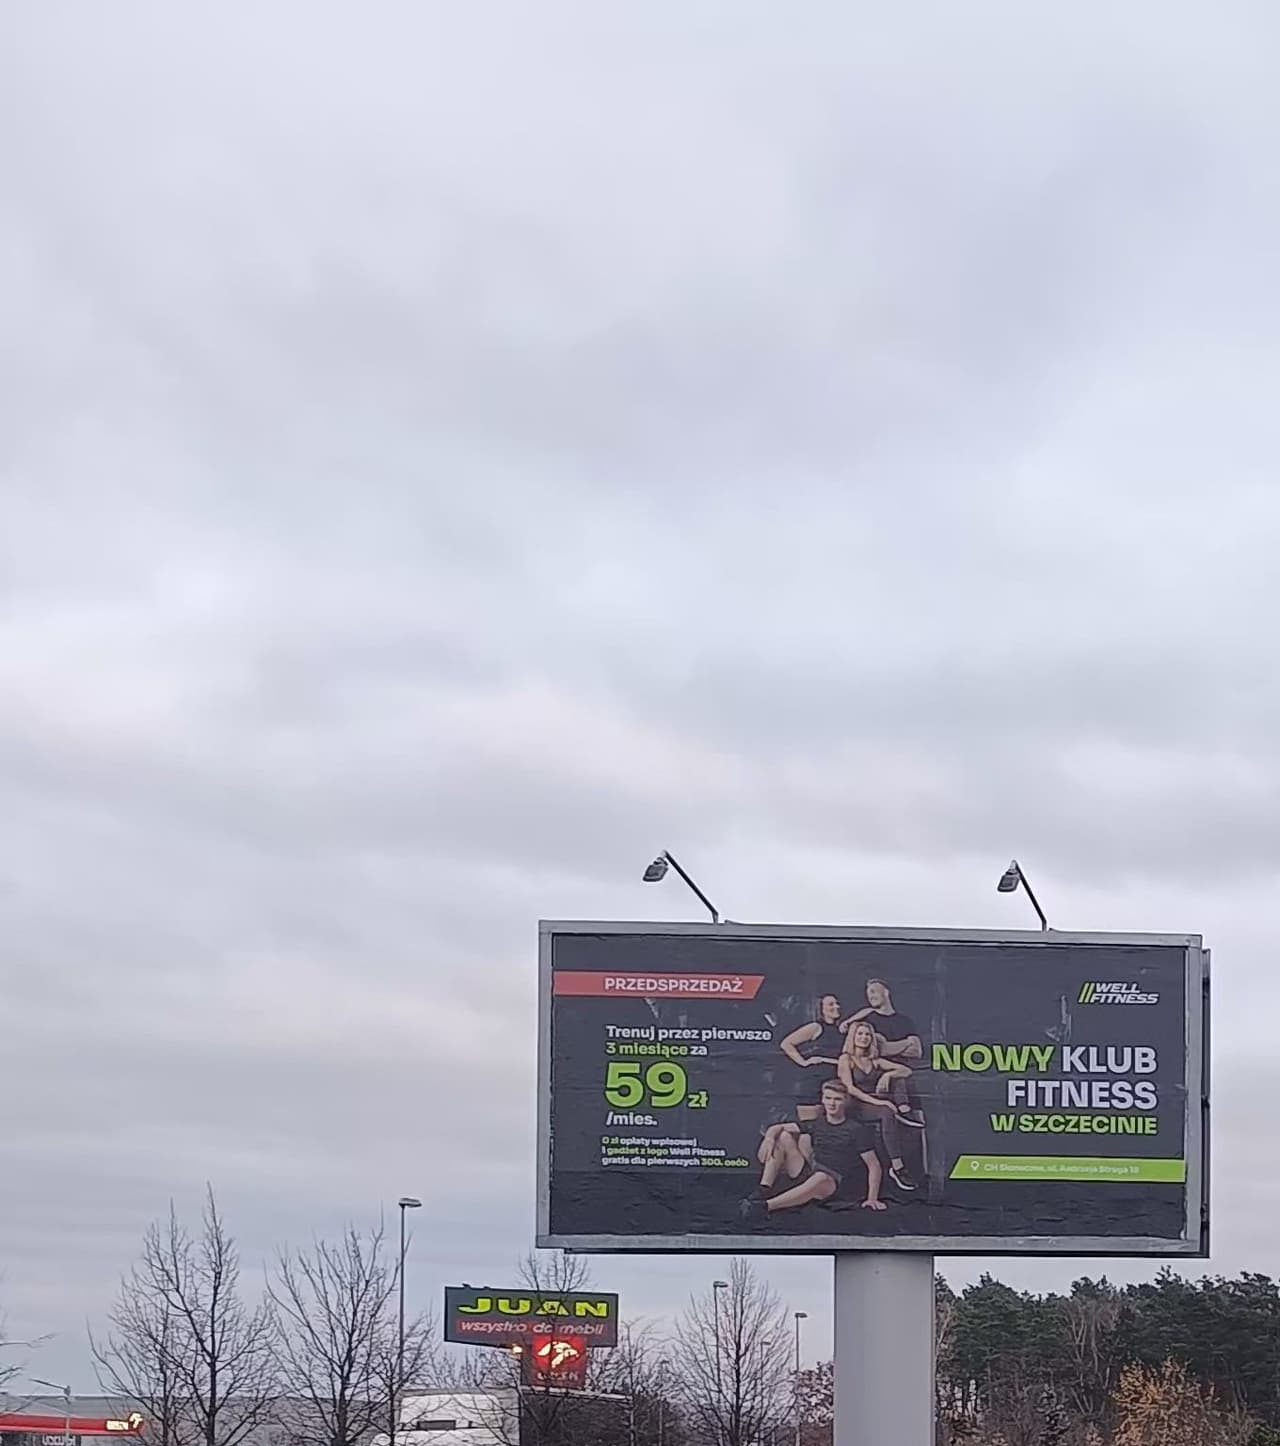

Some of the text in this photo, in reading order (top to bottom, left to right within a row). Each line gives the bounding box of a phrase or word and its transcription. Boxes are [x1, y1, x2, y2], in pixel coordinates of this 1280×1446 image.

[604, 977, 743, 993] PRZEDSPRZEDAŻ
[1095, 982, 1141, 994] WELL
[1090, 993, 1159, 1004] FITNESS
[606, 1025, 772, 1042] Trenuj przez pierwsze
[606, 1042, 708, 1058] 3 miesiące za
[931, 1044, 1158, 1073] NOWY KLUB
[605, 1062, 708, 1108] 59 zł
[1007, 1080, 1158, 1110] FITNESS
[606, 1111, 658, 1126] /mies.
[990, 1114, 1158, 1135] W SZCZECINIE
[646, 1147, 669, 1156] logo
[669, 1147, 691, 1155] Well
[691, 1148, 726, 1156] Fitness
[601, 1156, 630, 1166] gratis
[630, 1157, 646, 1165] dla
[647, 1157, 700, 1167] pierwszych
[458, 1298, 608, 1317] JUAN
